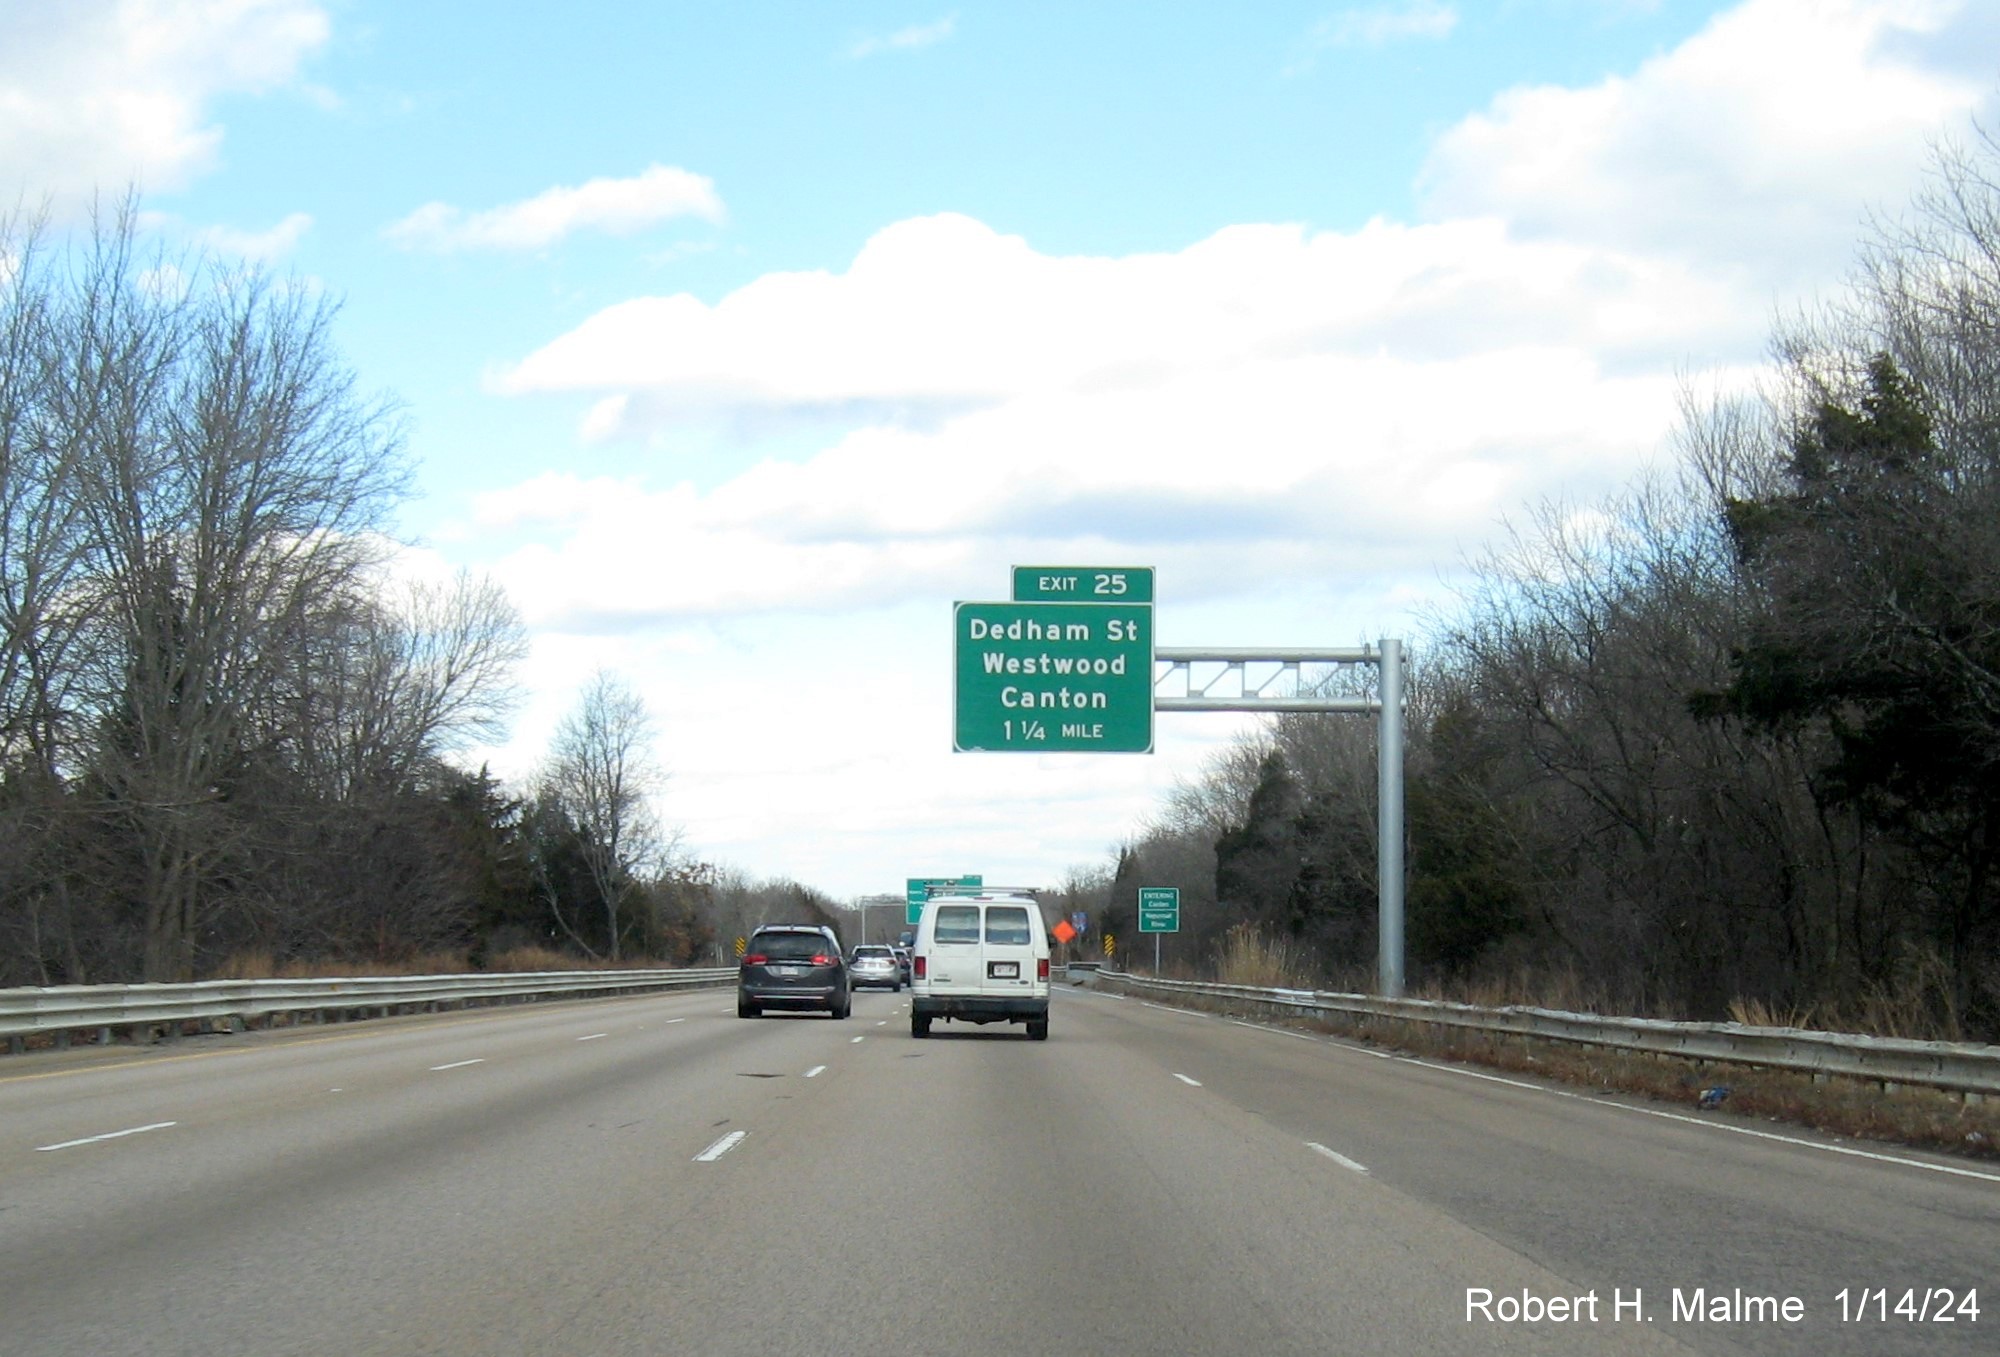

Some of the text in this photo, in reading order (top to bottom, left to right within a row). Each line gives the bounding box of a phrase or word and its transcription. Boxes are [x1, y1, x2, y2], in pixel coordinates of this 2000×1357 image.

[1039, 574, 1127, 595] EXIT 25
[970, 618, 1138, 641] Dedham St
[983, 652, 1125, 675] Westwood
[1001, 686, 1107, 709] Canton
[1004, 720, 1011, 741] 1
[1062, 724, 1103, 738] MILE
